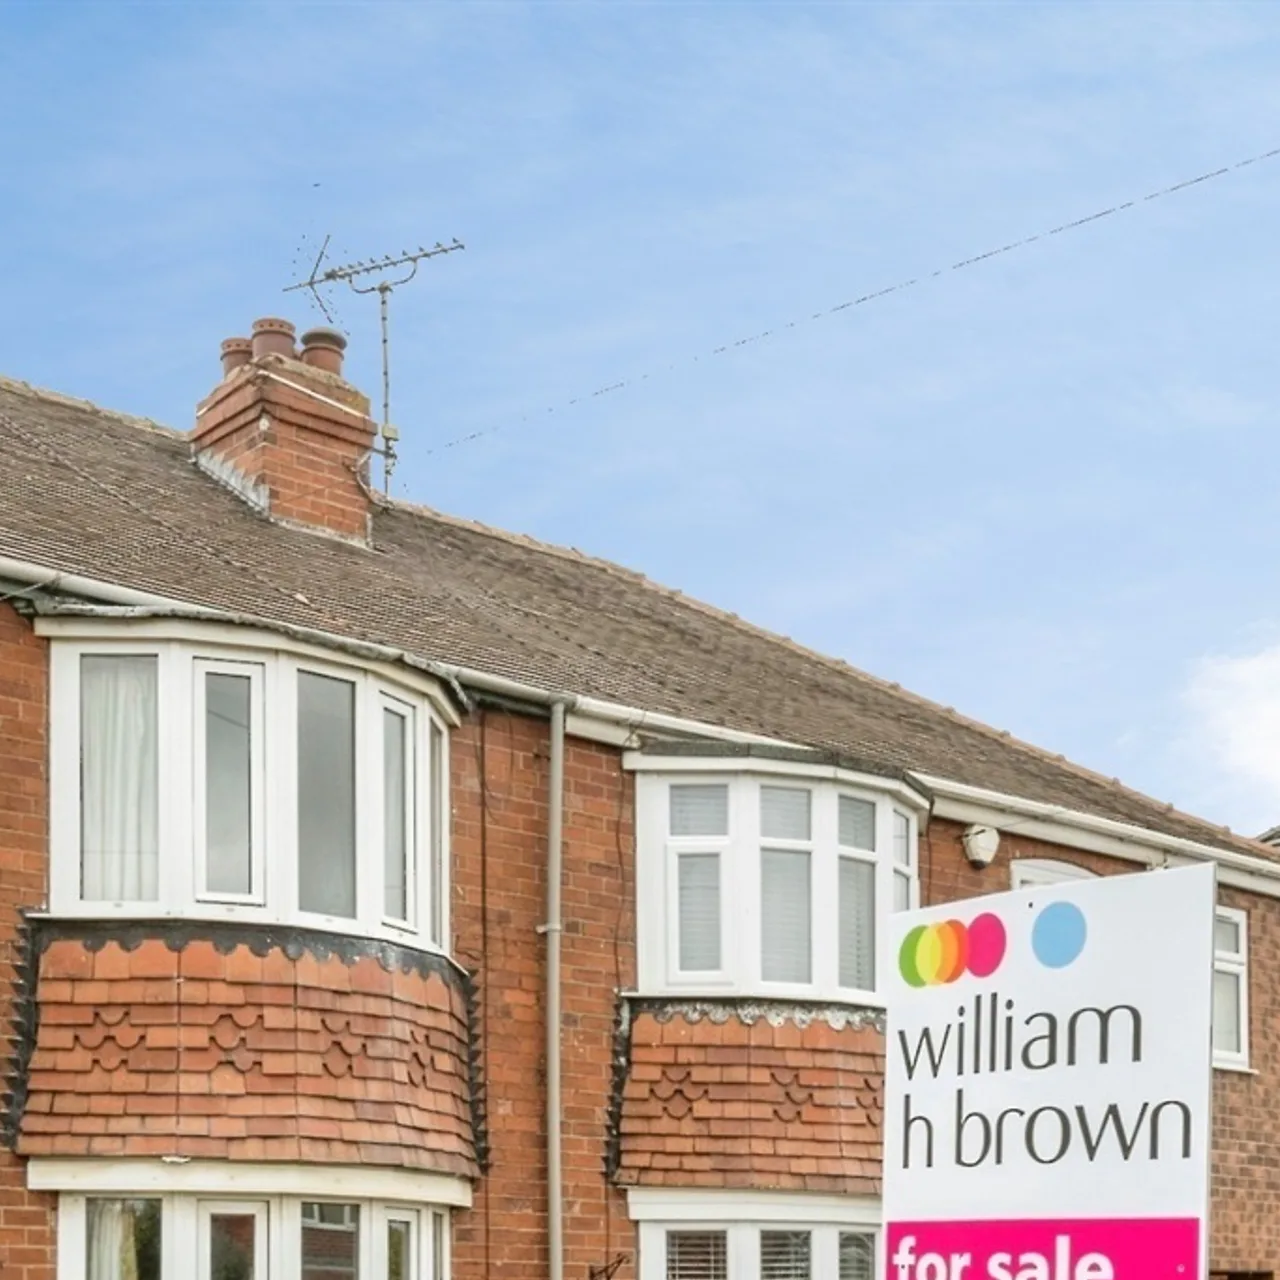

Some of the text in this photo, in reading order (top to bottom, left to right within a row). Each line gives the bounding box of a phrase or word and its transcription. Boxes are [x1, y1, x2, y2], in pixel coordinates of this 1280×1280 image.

[898, 992, 1143, 1081] william
[901, 1088, 1192, 1170] h brown
